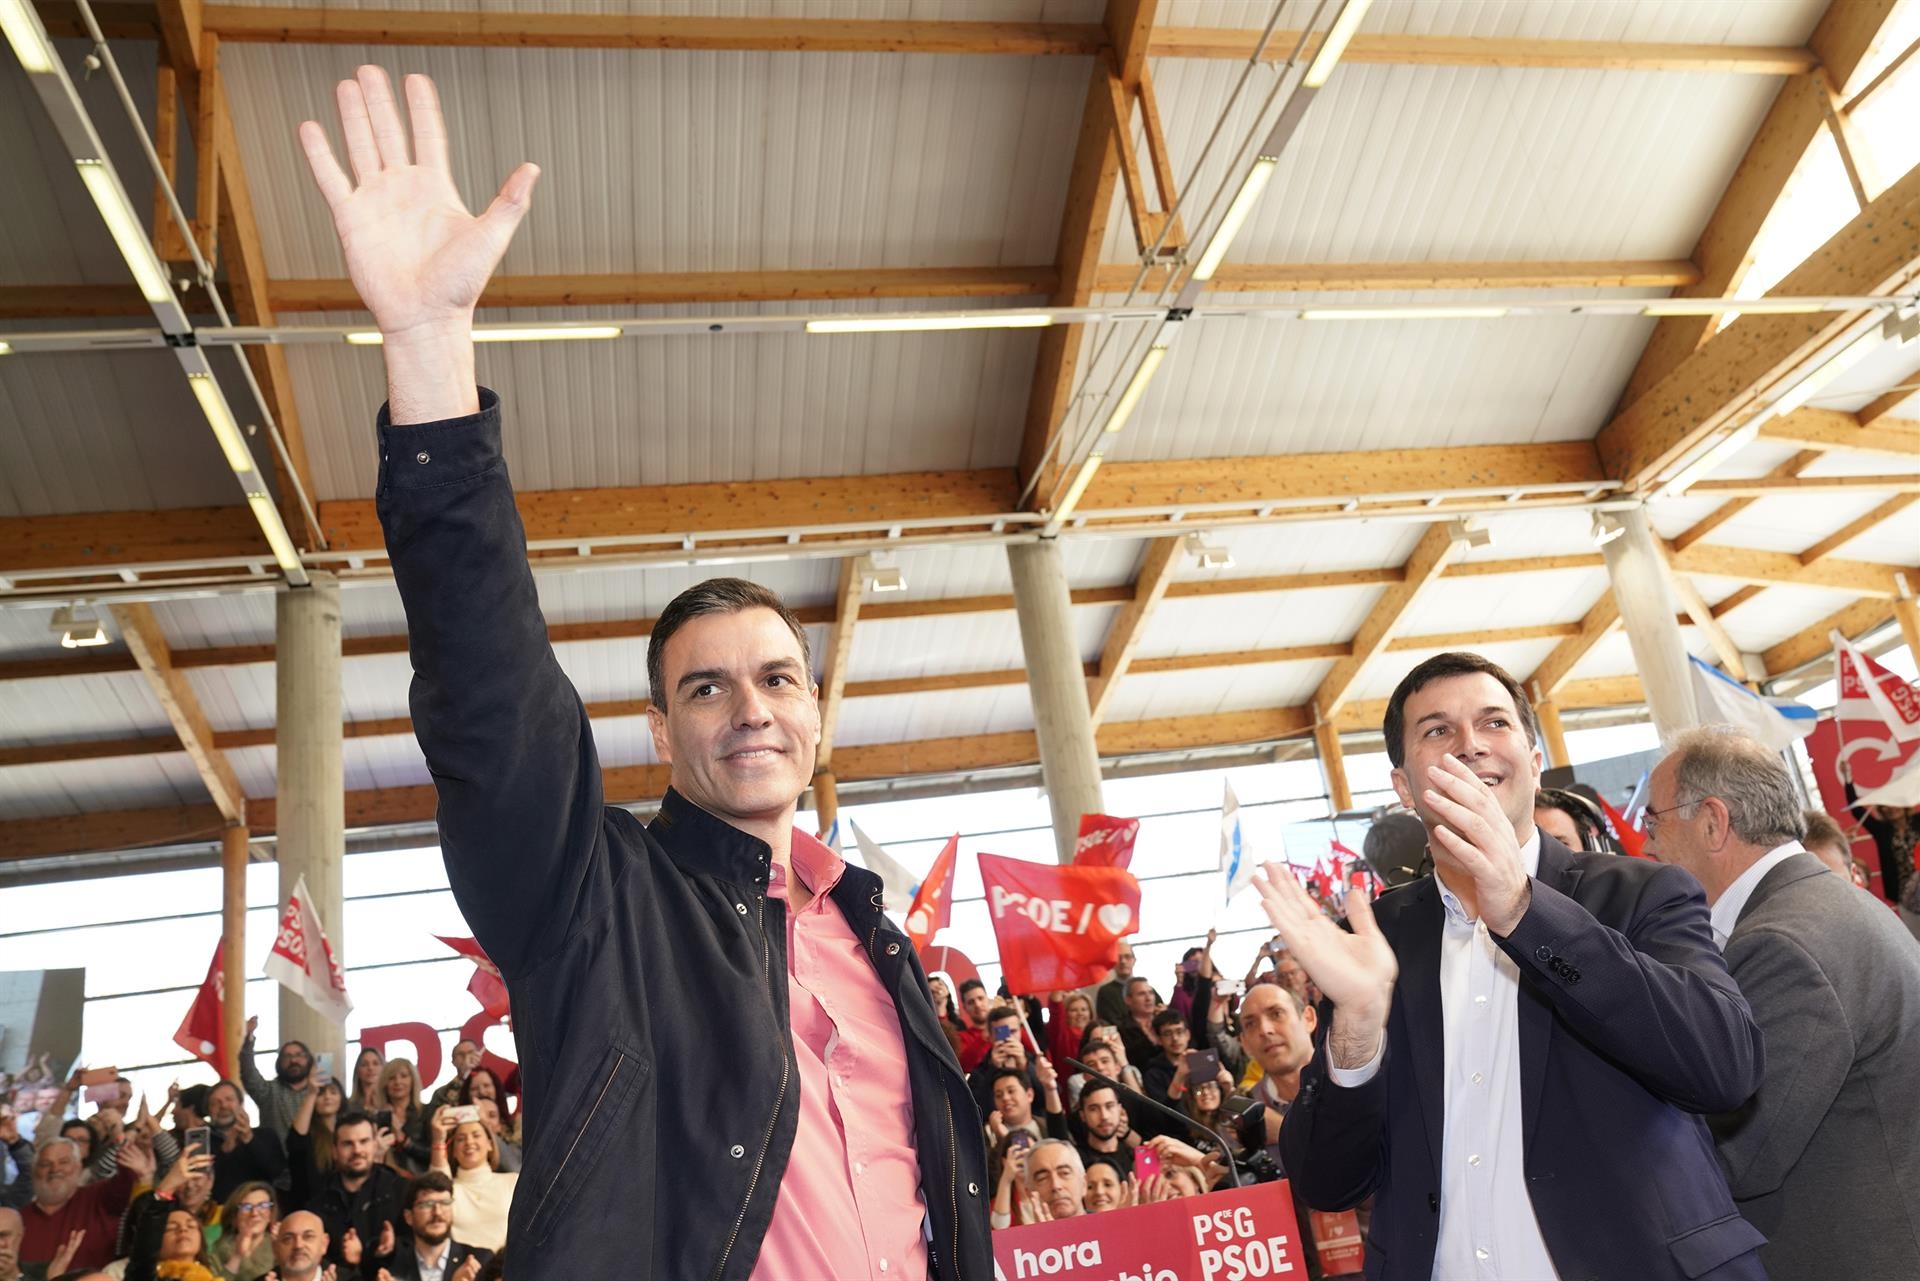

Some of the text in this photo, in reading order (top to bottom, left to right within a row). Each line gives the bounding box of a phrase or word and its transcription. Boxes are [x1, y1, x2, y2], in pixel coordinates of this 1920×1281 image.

[991, 885, 1073, 934] PSOE
[1013, 1239, 1103, 1280] hora
[1199, 1235, 1294, 1281] PSOE
